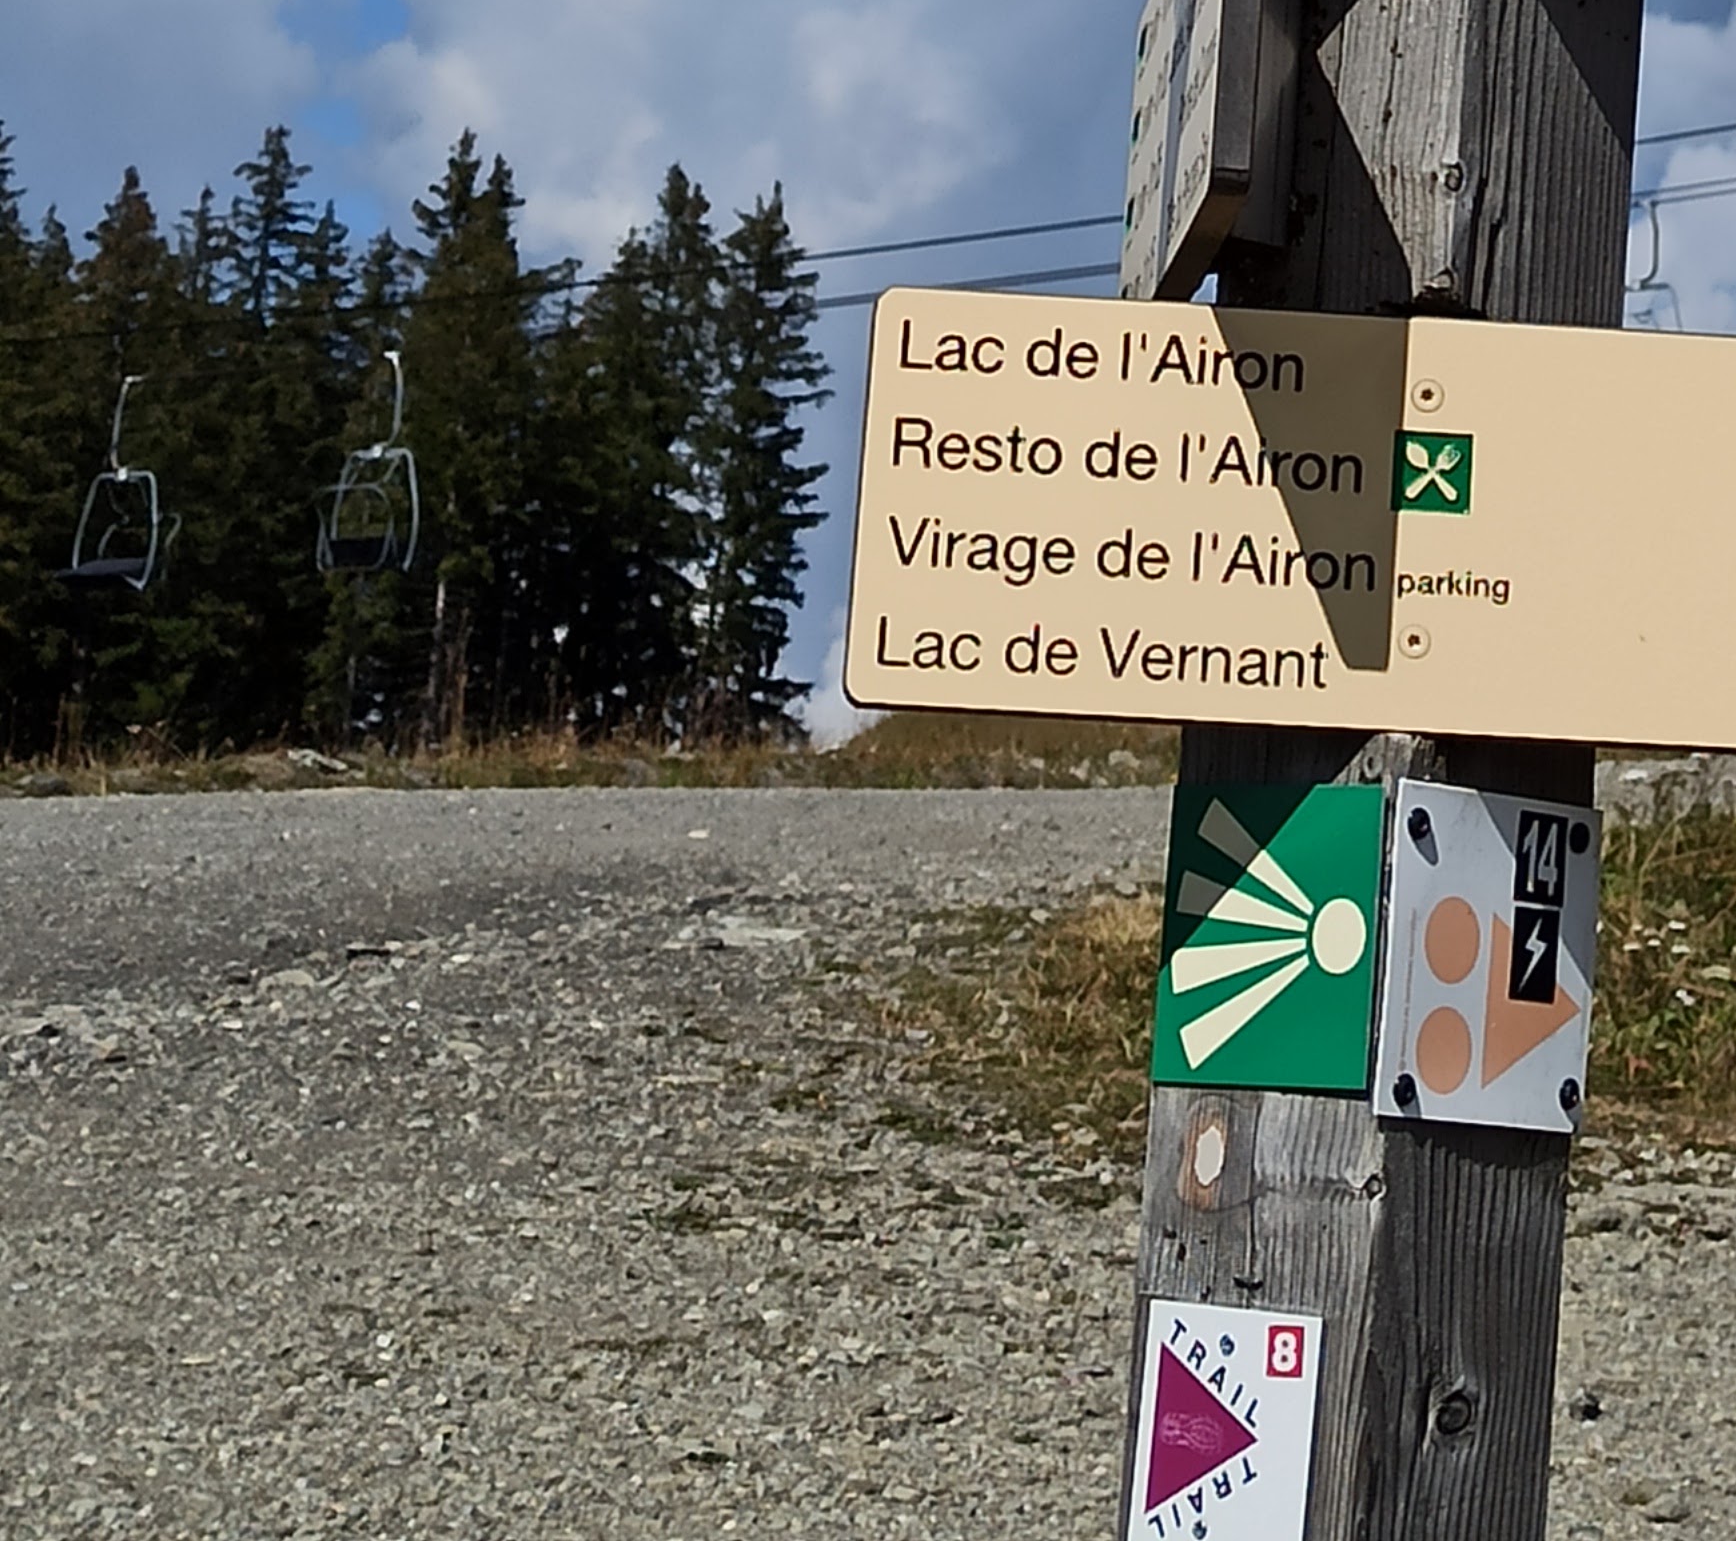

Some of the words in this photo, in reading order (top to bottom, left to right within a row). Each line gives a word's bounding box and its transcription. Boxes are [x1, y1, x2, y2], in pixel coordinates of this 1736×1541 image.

[900, 319, 1004, 374] Lac
[1027, 328, 1098, 379] de
[1121, 331, 1303, 392] l'Airon
[893, 417, 1062, 475] Resto
[1085, 431, 1157, 480] de
[1180, 432, 1363, 494] l'Airon
[889, 516, 1075, 586] Virage
[1097, 528, 1170, 580] de
[1192, 532, 1376, 592] l'Airon
[1397, 570, 1510, 605] parking
[877, 616, 981, 671] Lac
[1005, 624, 1078, 675] de
[1101, 627, 1328, 689] Vernant
[1522, 819, 1558, 897] 14
[1170, 1319, 1258, 1428] TRAIL
[1272, 1332, 1297, 1372] 8
[1149, 1457, 1258, 1538] TRAIL
